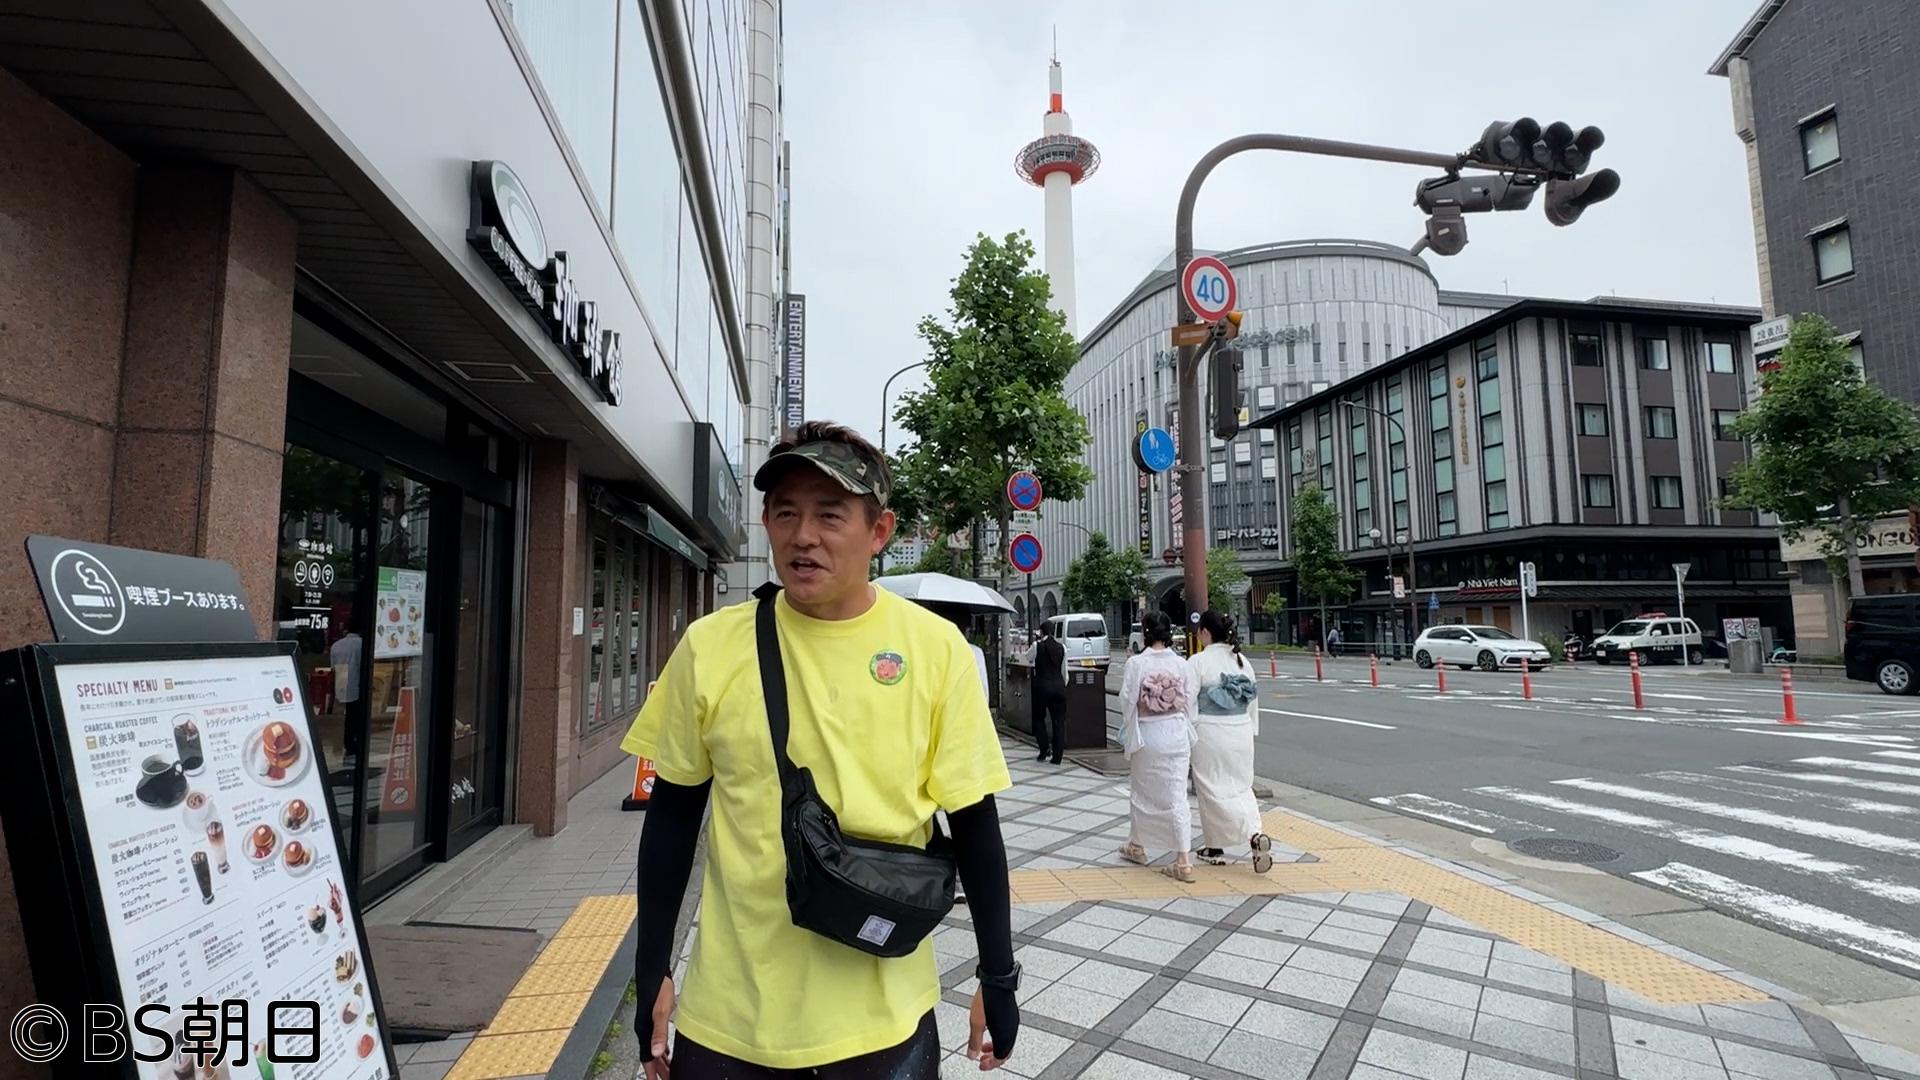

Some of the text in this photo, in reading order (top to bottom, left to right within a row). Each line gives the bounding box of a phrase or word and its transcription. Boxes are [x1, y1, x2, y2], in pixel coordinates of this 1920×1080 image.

[1196, 274, 1225, 305] 40
[551, 250, 623, 407] 珈琲館
[788, 300, 803, 428] ENTERTAINMENT HUB
[1499, 577, 1518, 587] Nam
[125, 585, 246, 611] 喫煙ブースあります。
[77, 680, 129, 698] SPECIALTY
[133, 679, 158, 693] MENU
[84, 715, 158, 733] CHARCOAL ROASTED COFFEE
[98, 731, 136, 748] 炭火珈琲
[135, 936, 186, 967] オリジナルコーヒー
